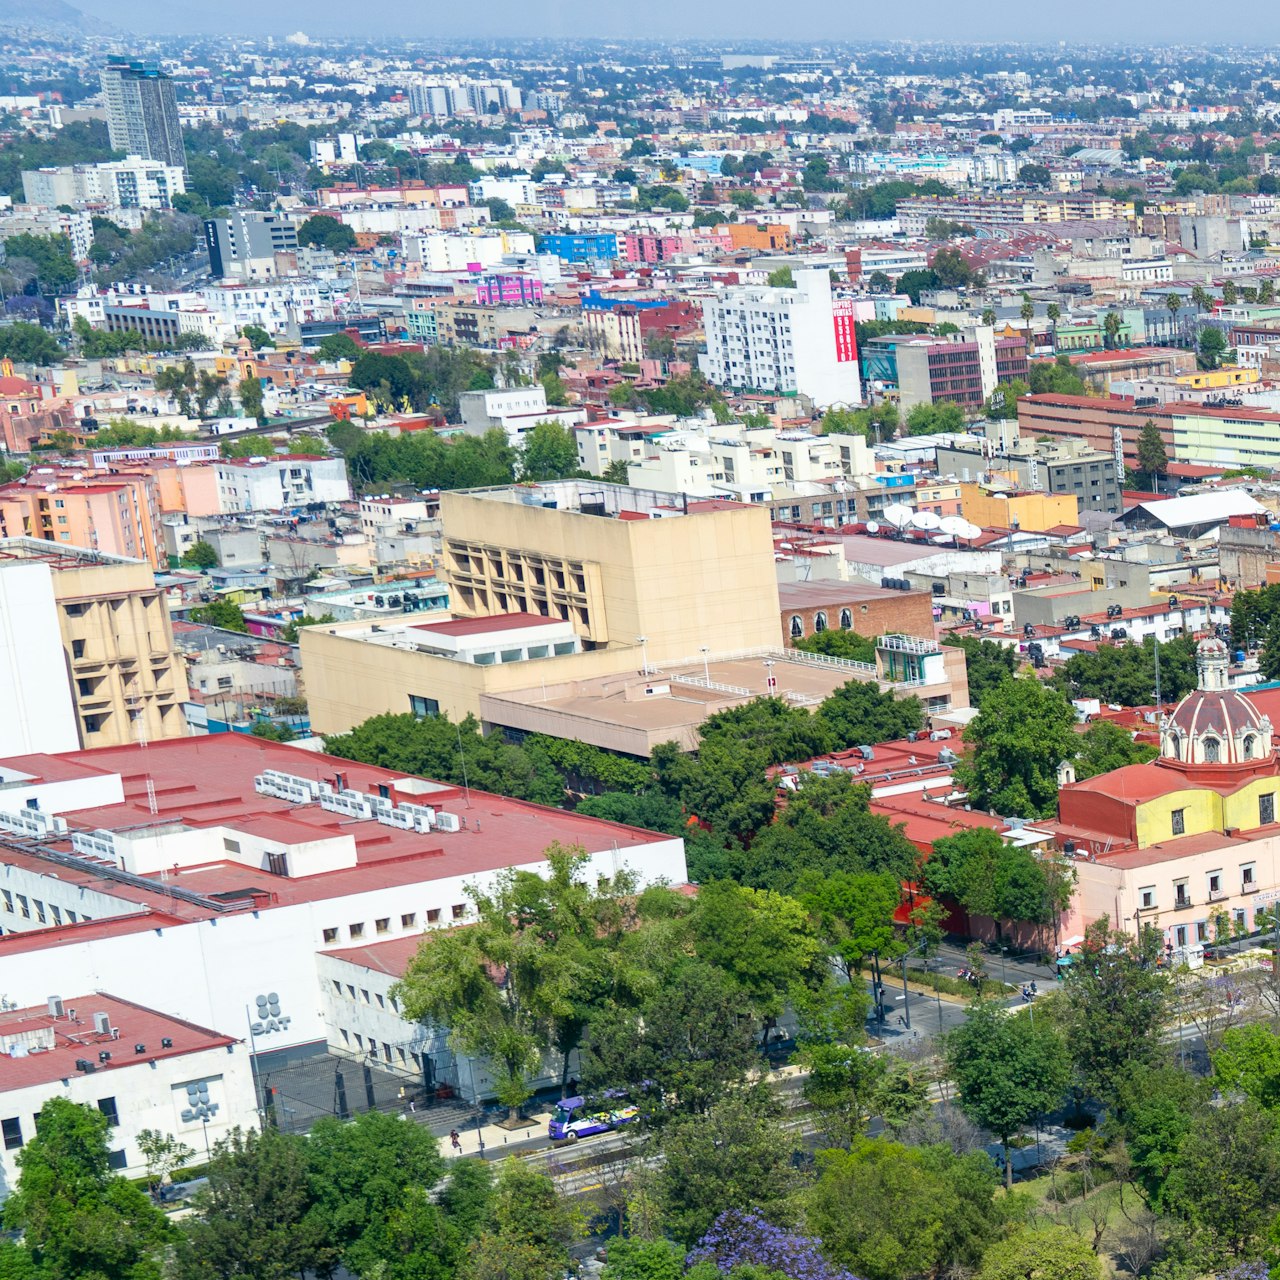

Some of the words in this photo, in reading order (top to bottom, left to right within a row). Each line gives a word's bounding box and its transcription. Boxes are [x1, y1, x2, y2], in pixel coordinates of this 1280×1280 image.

[832, 300, 852, 309] DEPTOS
[833, 308, 853, 316] VENTAS
[251, 1016, 291, 1036] SAT
[181, 1103, 219, 1123] SAT
